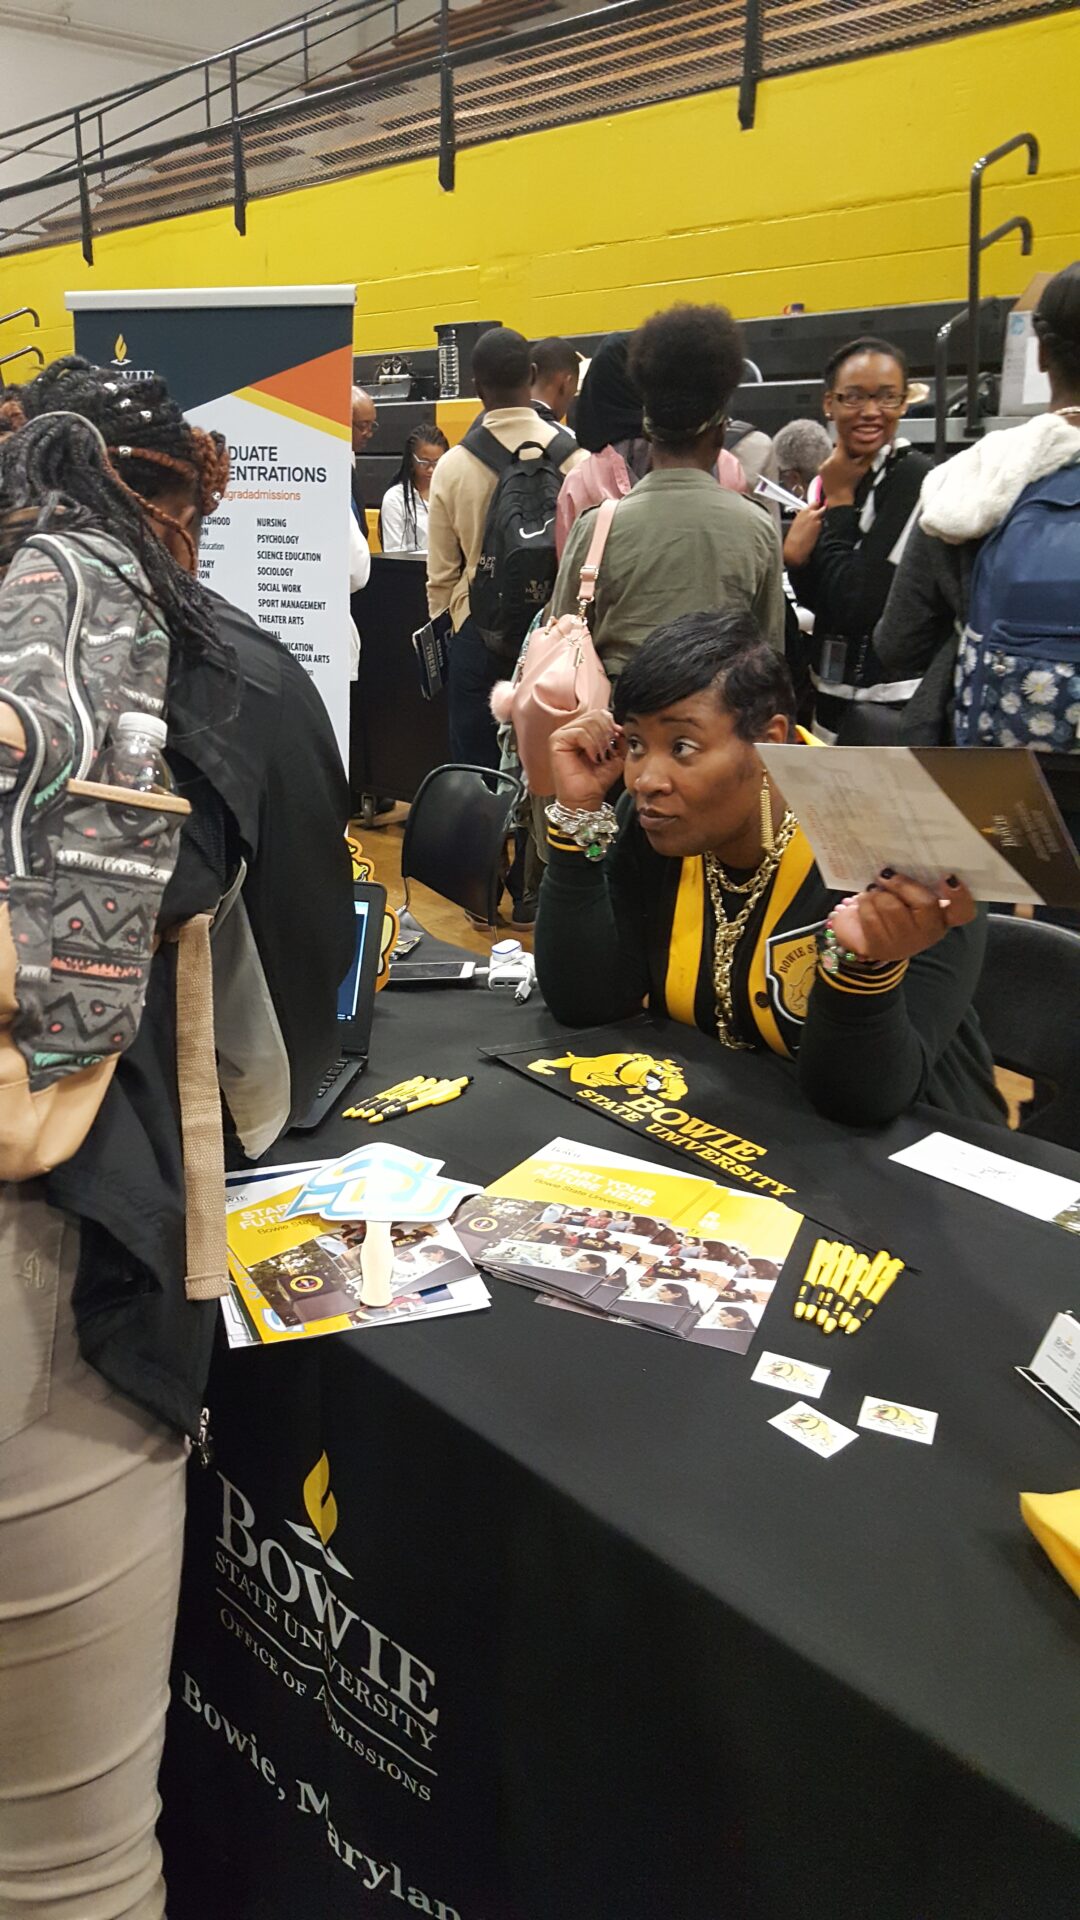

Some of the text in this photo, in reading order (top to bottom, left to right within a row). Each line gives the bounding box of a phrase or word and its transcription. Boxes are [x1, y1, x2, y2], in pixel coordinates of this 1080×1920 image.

[229, 446, 278, 461] DUATE
[229, 466, 327, 483] ENTRATIONS
[257, 518, 287, 527] NURSING
[257, 535, 299, 544] PSYCHOLOGY
[257, 551, 321, 561] SCIENCE EDUCATION
[257, 567, 294, 576] SOCIOLOGY
[257, 583, 302, 593] SOCIAL WORK
[258, 599, 326, 611] SPORT MANAGEMENT
[258, 615, 305, 626] THEATER ARTS
[313, 655, 331, 664] ARTS
[779, 946, 806, 974] BOWIE
[624, 1095, 768, 1163] BOWIE
[576, 1089, 796, 1197] STATE UNIVERSITY
[240, 1203, 290, 1220] STAR
[216, 1470, 439, 1726] BOWIE
[216, 1551, 437, 1751] STATE UNIVERSITY
[220, 1608, 279, 1675] OFFICE
[283, 1671, 307, 1697] OF
[182, 1670, 462, 1919] Bowie, Marylan
